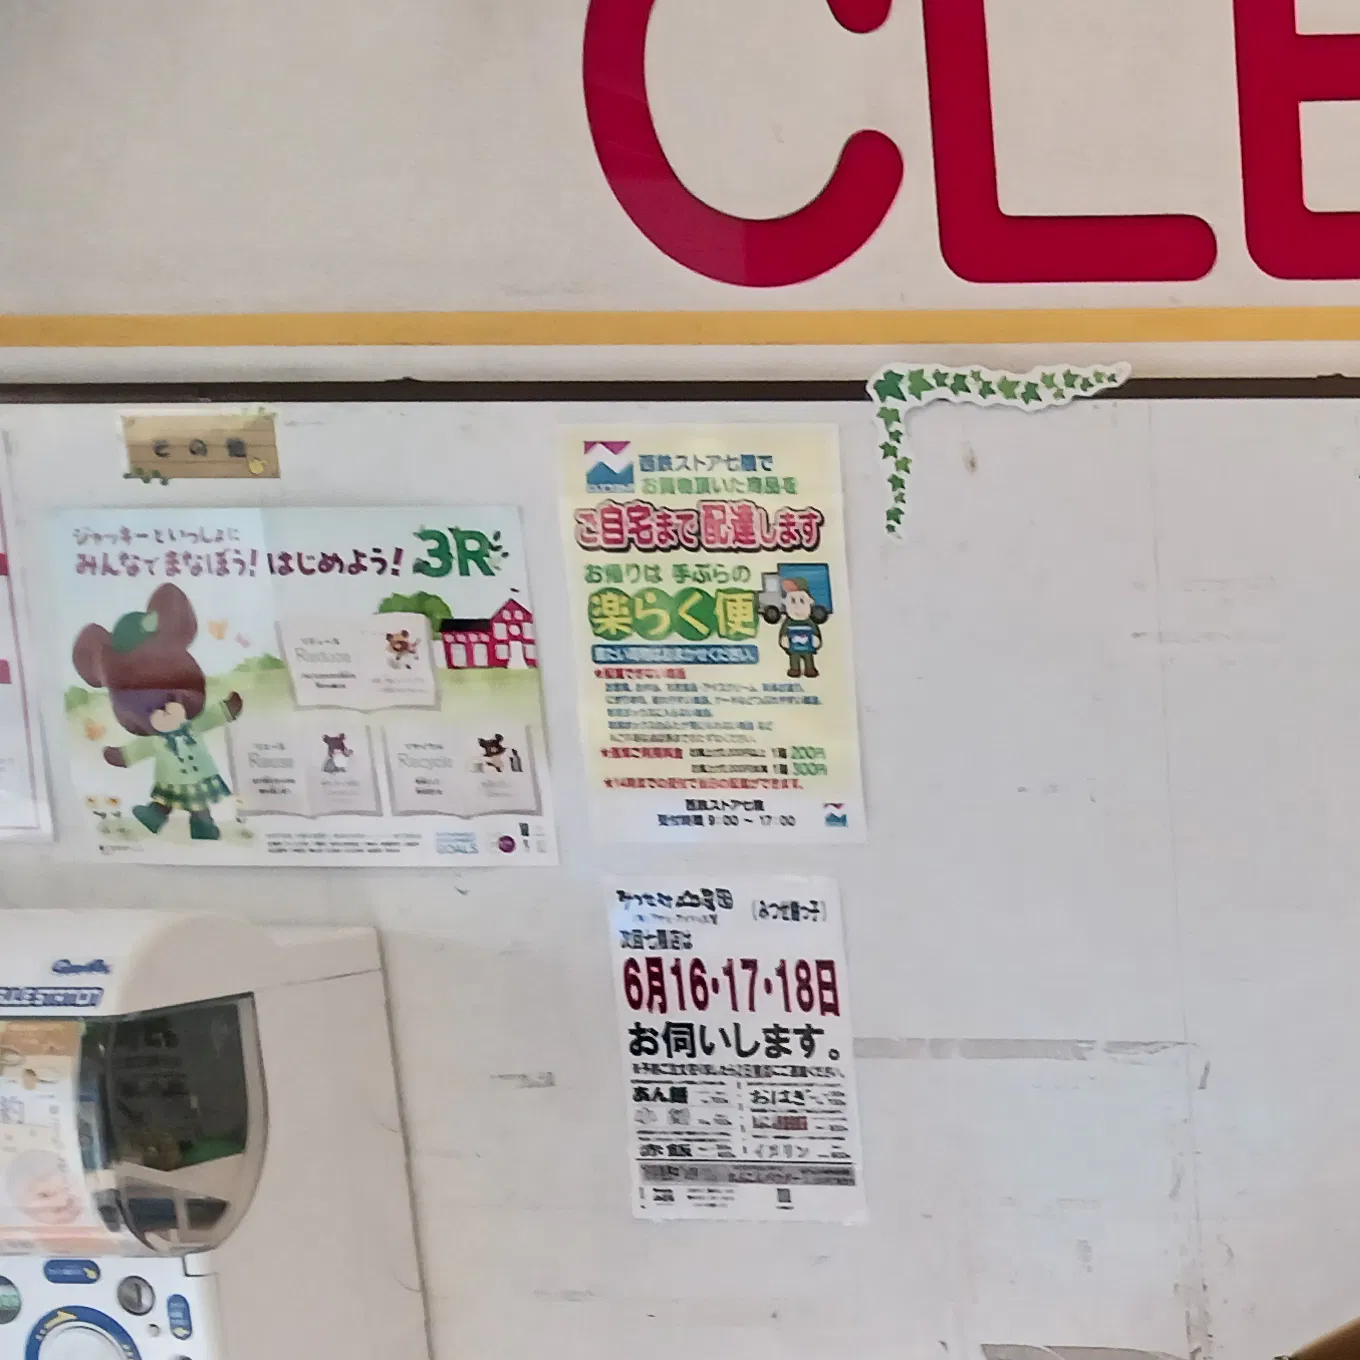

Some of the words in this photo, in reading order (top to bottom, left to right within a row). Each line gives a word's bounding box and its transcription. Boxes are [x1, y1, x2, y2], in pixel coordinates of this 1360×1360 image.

[574, 498, 825, 553] ご自宅まで配達します
[413, 526, 498, 578] 3R
[591, 588, 759, 639] 楽らく便
[622, 956, 841, 1017] 6月16・17・18日
[628, 1021, 841, 1061] お伺いします。
